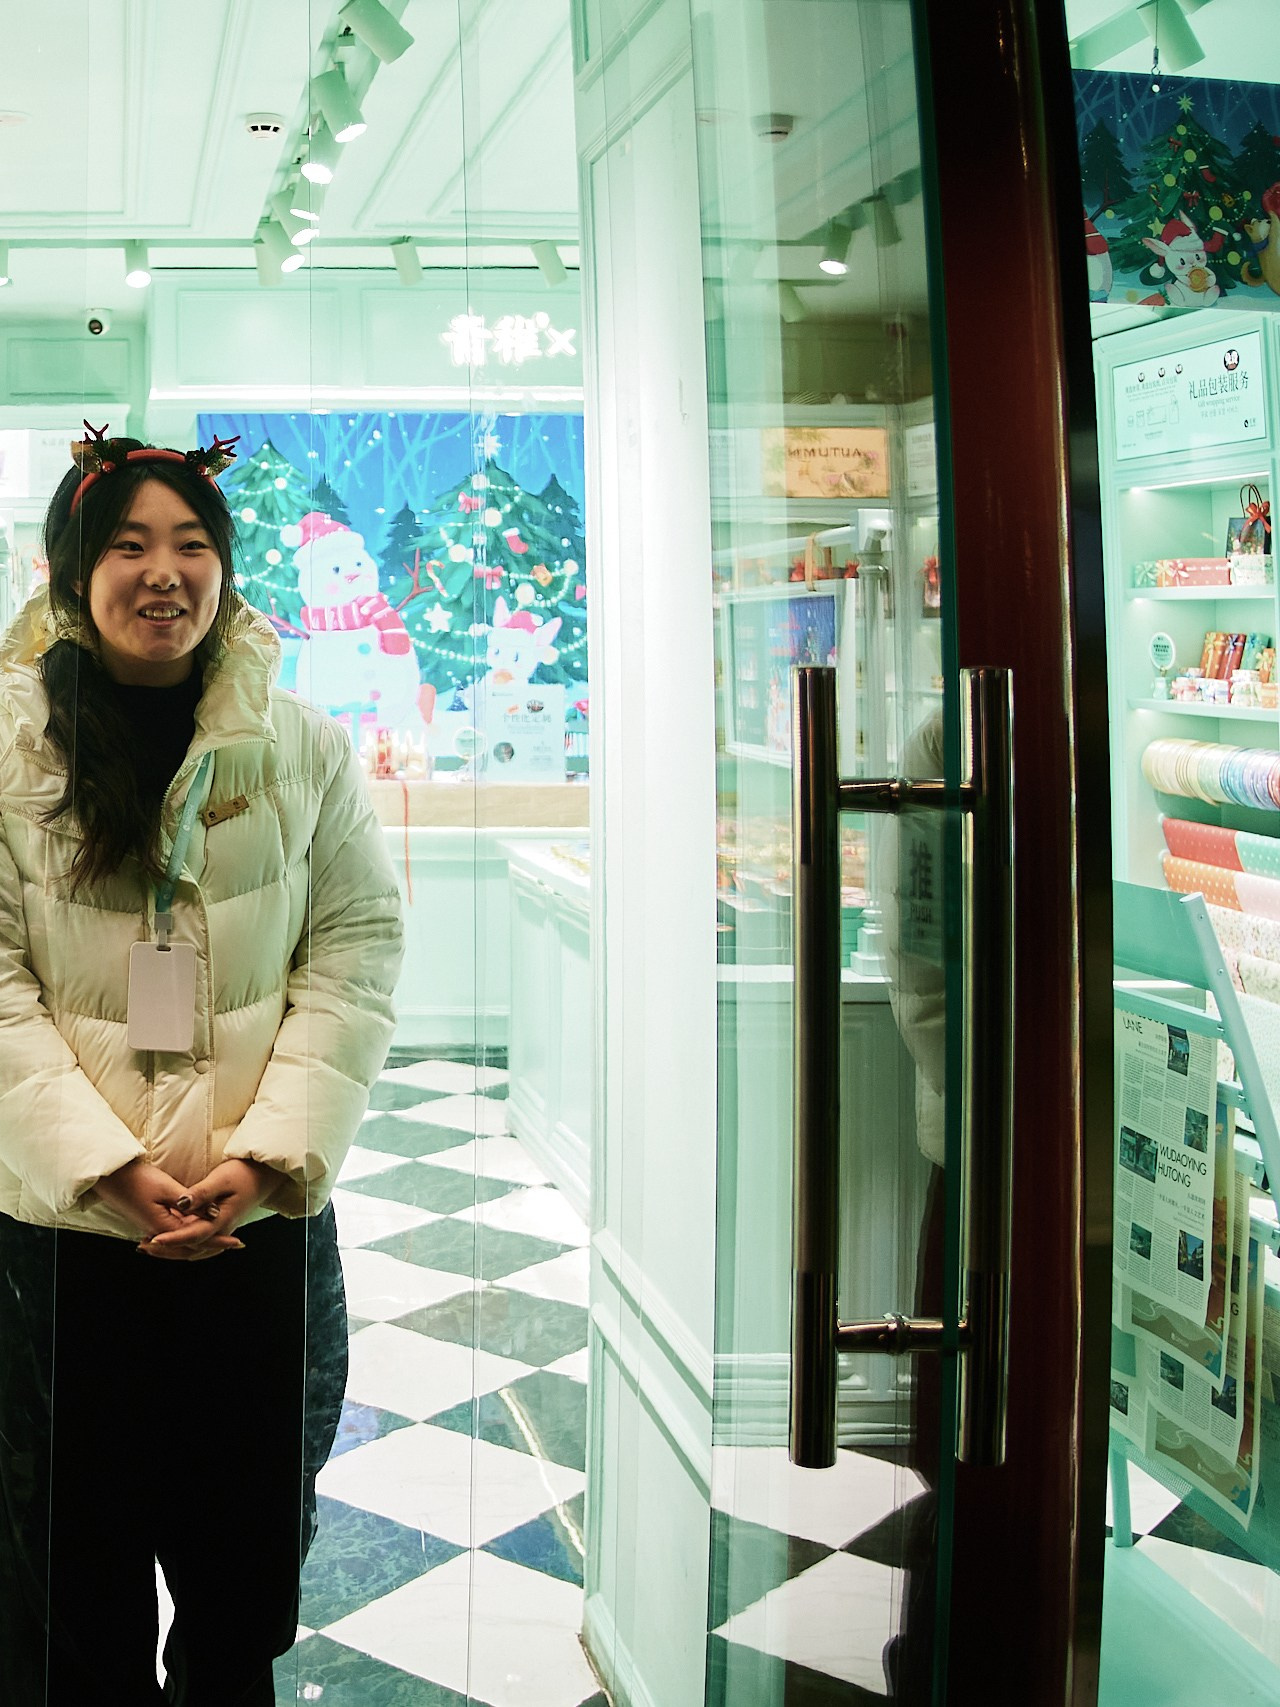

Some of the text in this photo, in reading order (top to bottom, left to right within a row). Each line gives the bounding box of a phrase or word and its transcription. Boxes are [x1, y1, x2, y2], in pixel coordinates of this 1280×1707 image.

[1188, 371, 1249, 400] 礼品包装服务
[1122, 1017, 1143, 1035] LANE
[1159, 1143, 1208, 1176] WUDAOYING
[1158, 1162, 1191, 1188] HUTONG
